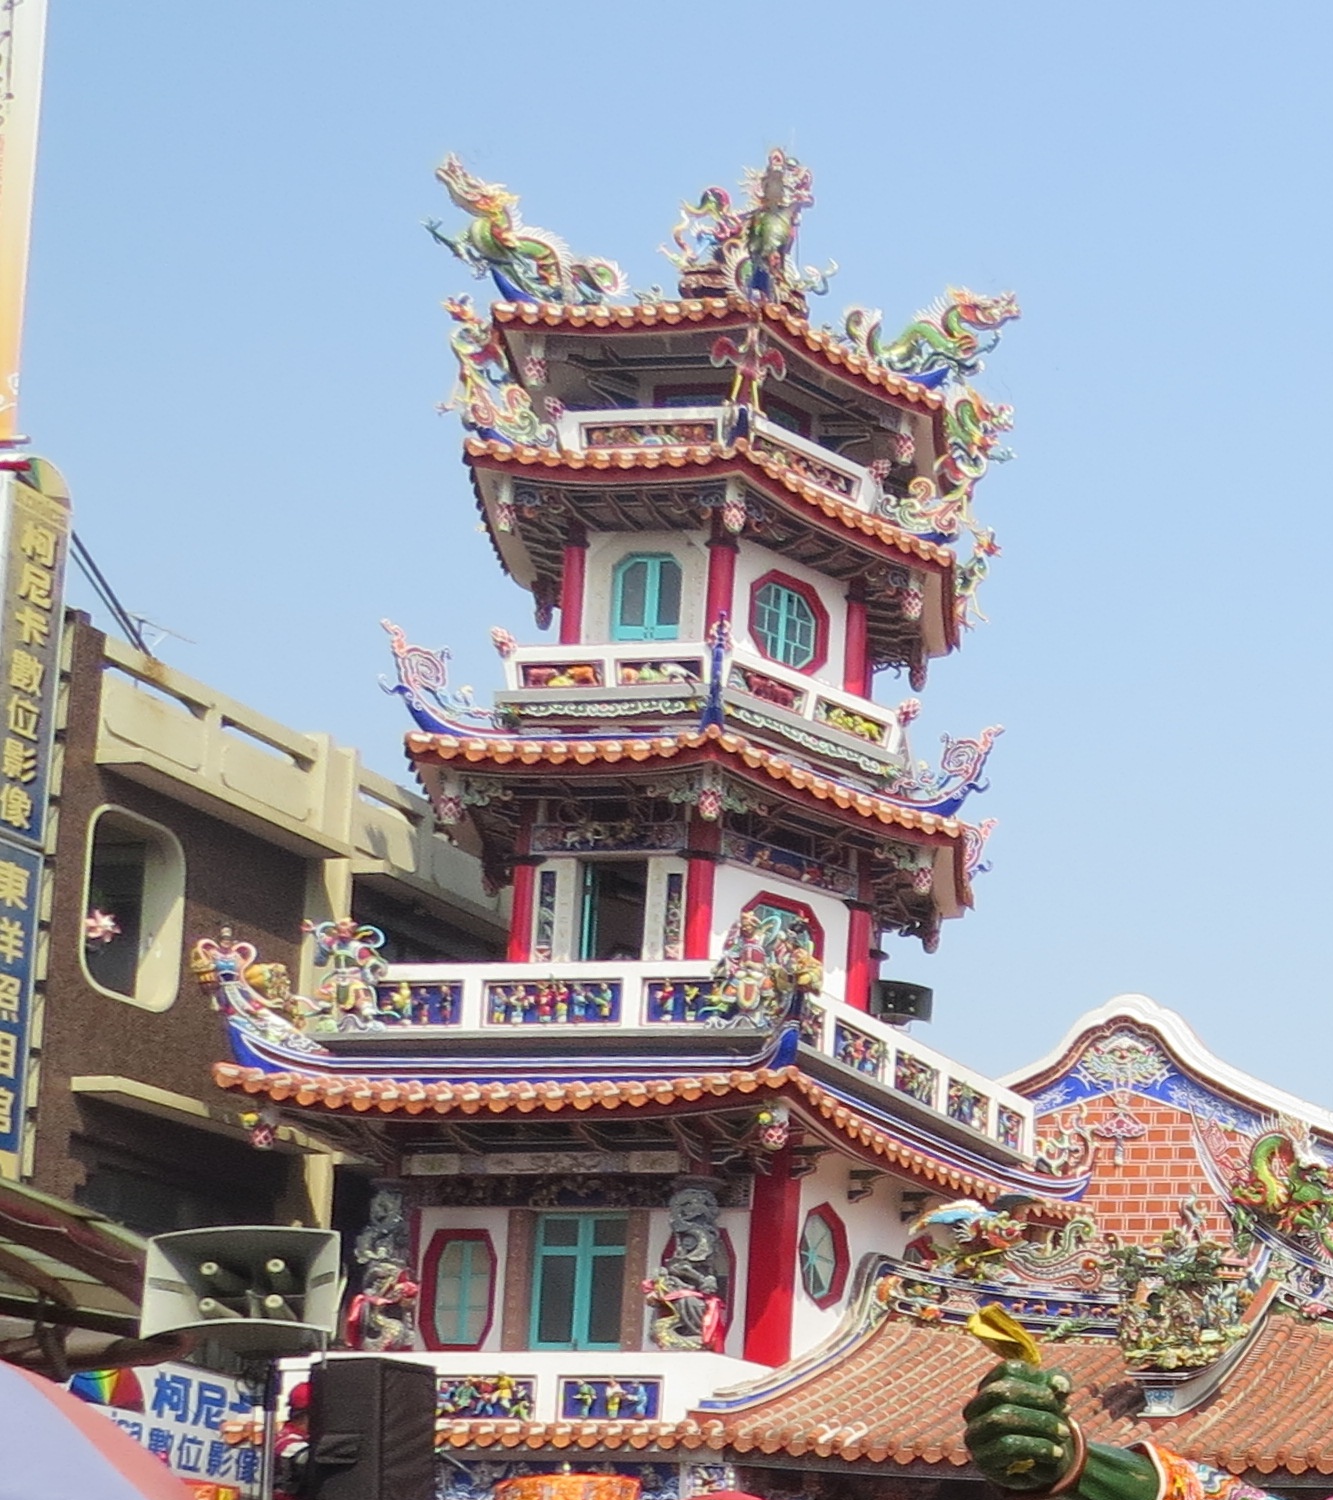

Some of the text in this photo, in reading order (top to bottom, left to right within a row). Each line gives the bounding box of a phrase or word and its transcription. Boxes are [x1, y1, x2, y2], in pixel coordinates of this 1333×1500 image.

[1, 520, 58, 830] 柯尼卡數位影像
